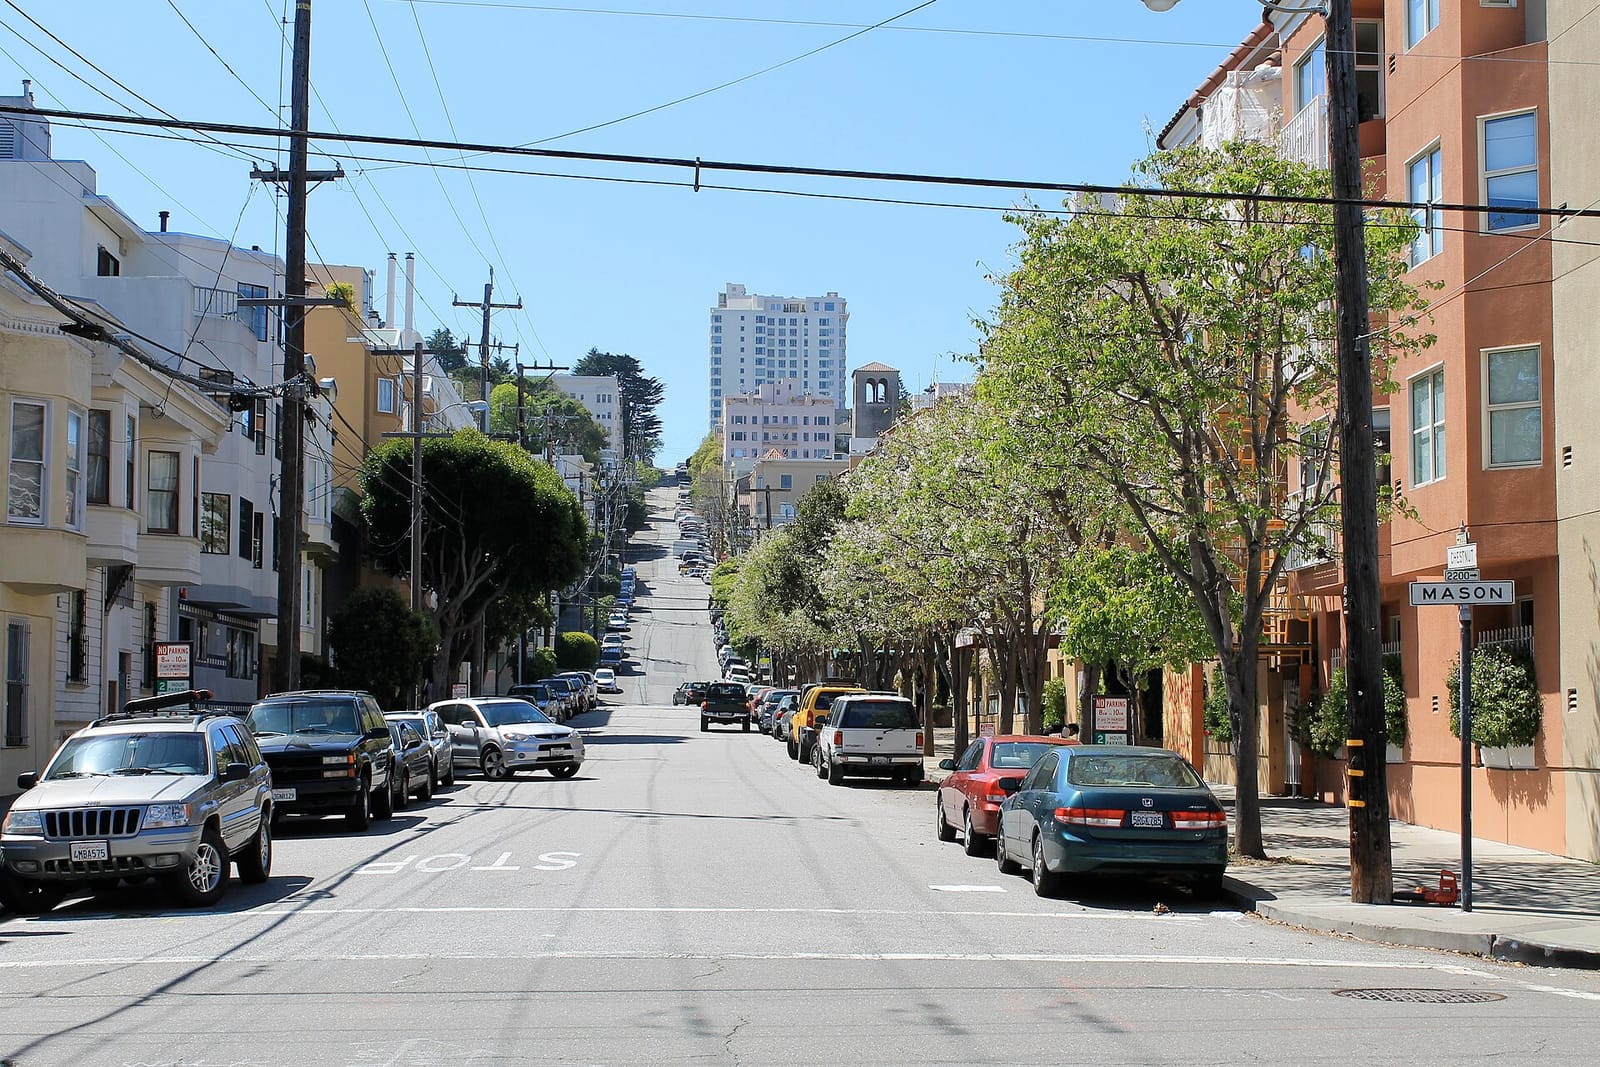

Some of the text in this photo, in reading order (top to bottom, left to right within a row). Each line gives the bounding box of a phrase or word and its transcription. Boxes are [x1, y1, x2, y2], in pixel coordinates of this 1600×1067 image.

[1447, 572, 1470, 581] 2200
[1423, 587, 1503, 600] MASON
[159, 646, 189, 655] NO PARKING
[159, 682, 166, 691] 2
[1096, 698, 1105, 708] NO
[1097, 734, 1104, 744] 2
[73, 848, 106, 860] 4MBA575
[352, 851, 583, 874] STOP
